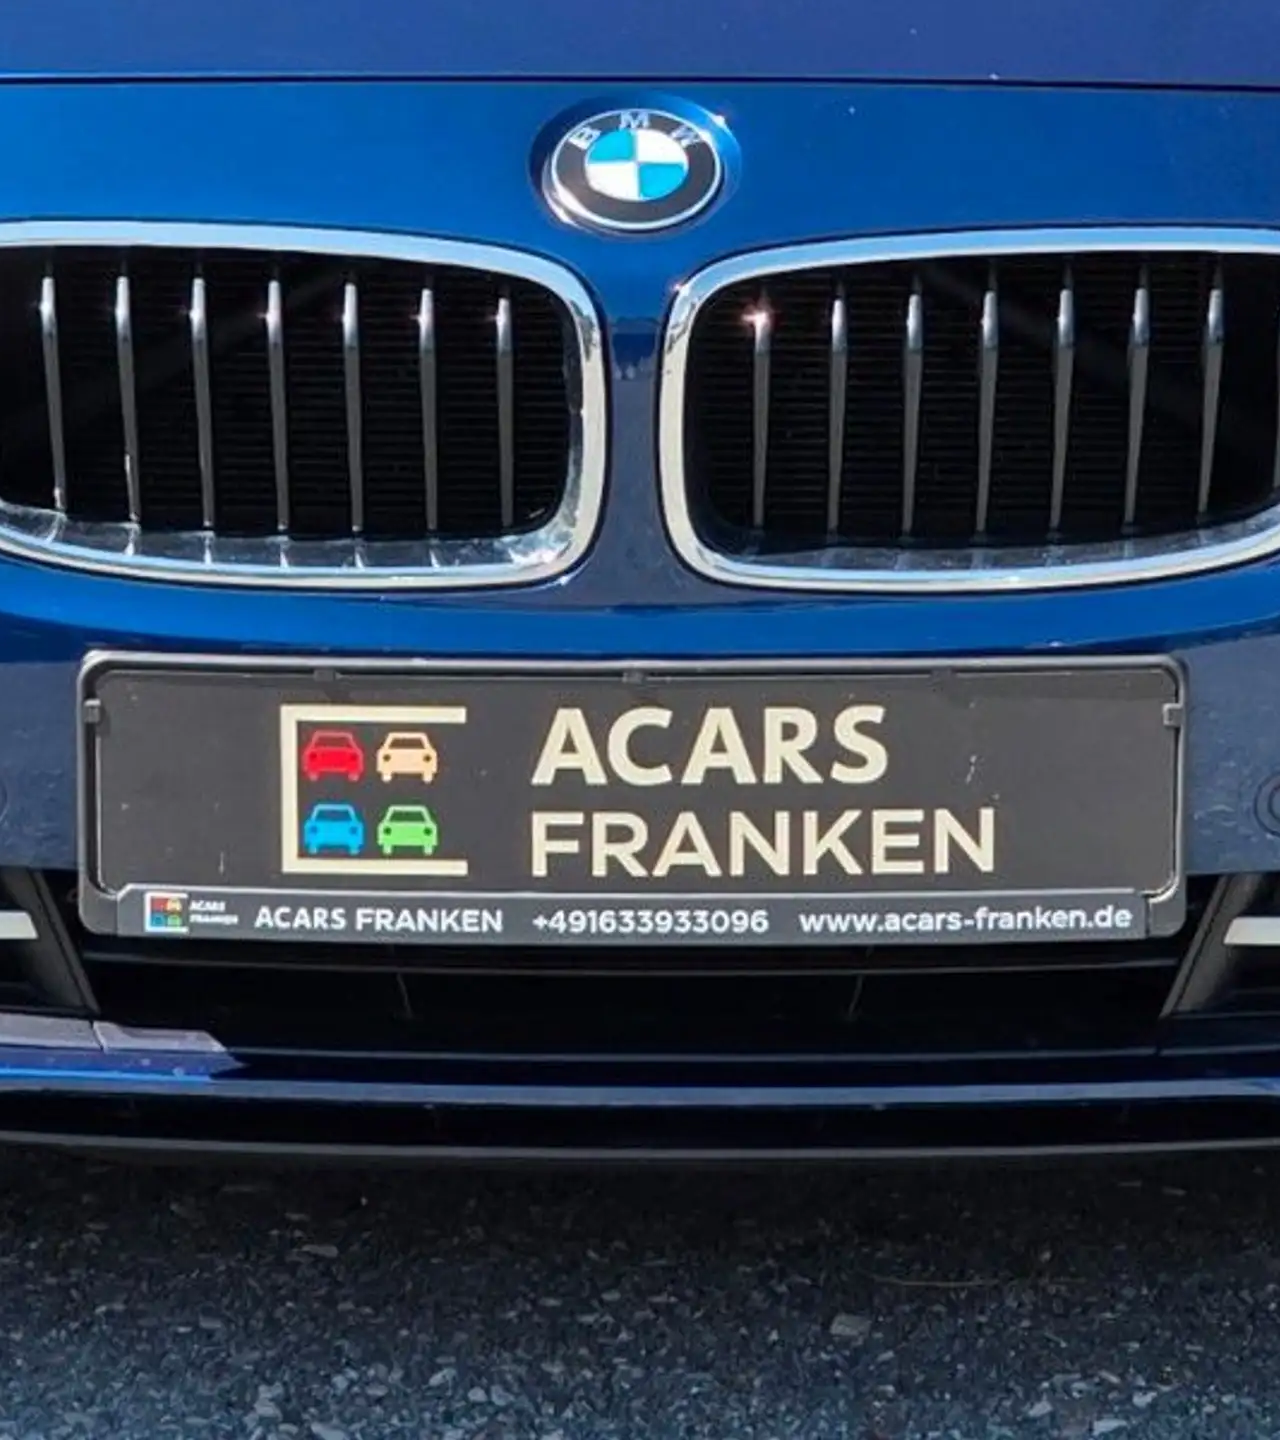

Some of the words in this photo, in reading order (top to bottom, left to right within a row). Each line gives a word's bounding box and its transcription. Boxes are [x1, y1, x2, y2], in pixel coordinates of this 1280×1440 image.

[568, 111, 700, 150] BMW
[531, 705, 889, 786] ACARS
[531, 806, 995, 878] FRANKEN
[254, 906, 346, 931] ACARS
[355, 908, 503, 933] FRANKEN
[532, 908, 770, 935] +491633933096
[799, 906, 1132, 934] www.acars-franken.de
